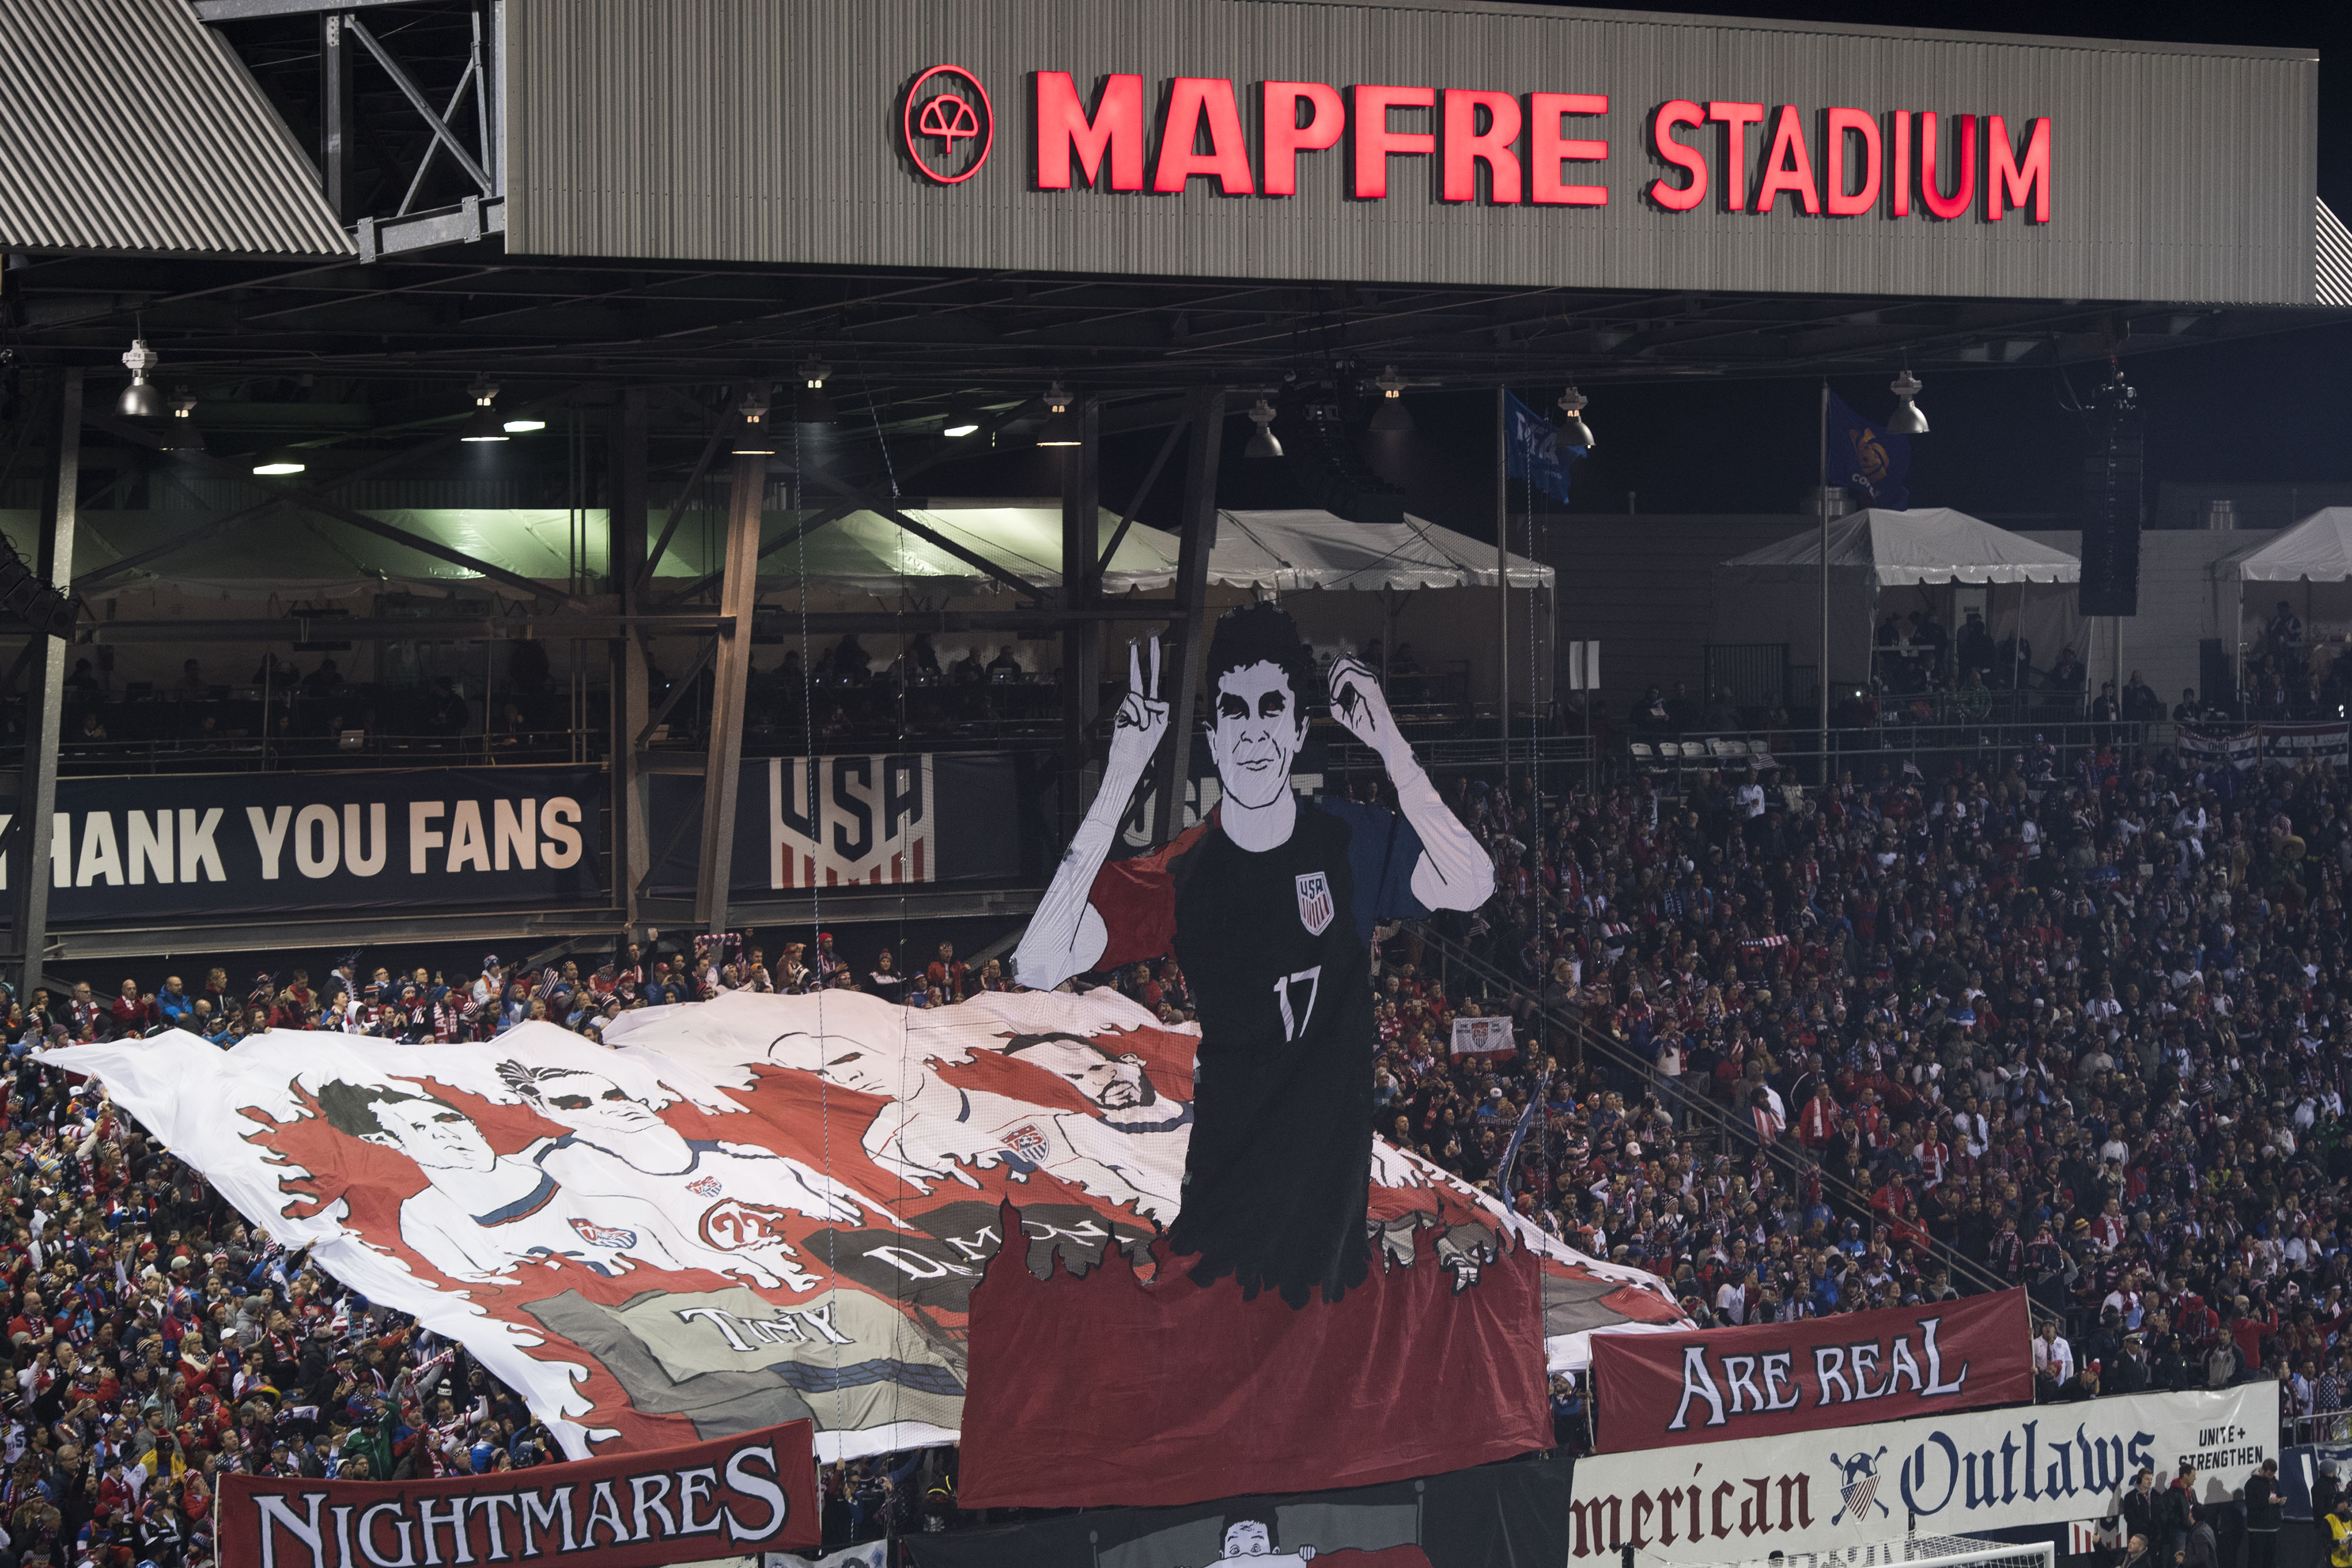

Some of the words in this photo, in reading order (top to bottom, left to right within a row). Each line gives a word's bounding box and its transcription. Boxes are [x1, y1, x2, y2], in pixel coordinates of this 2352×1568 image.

[1037, 69, 1609, 206] MAPFRE
[1650, 99, 2052, 223] STADIUM
[246, 803, 386, 880] YOU
[409, 797, 583, 874] FANS
[780, 754, 924, 863] USA
[1299, 878, 1324, 900] USA
[1274, 965, 1321, 1042] 17
[1669, 1346, 1799, 1431] ARE
[1815, 1317, 1967, 1407] REAL
[1900, 1419, 2155, 1515] Outlaws
[2179, 1445, 2263, 1470] STRENGTHEN
[2199, 1425, 2235, 1447] UNITE
[252, 1445, 790, 1568] NIGHTMARES
